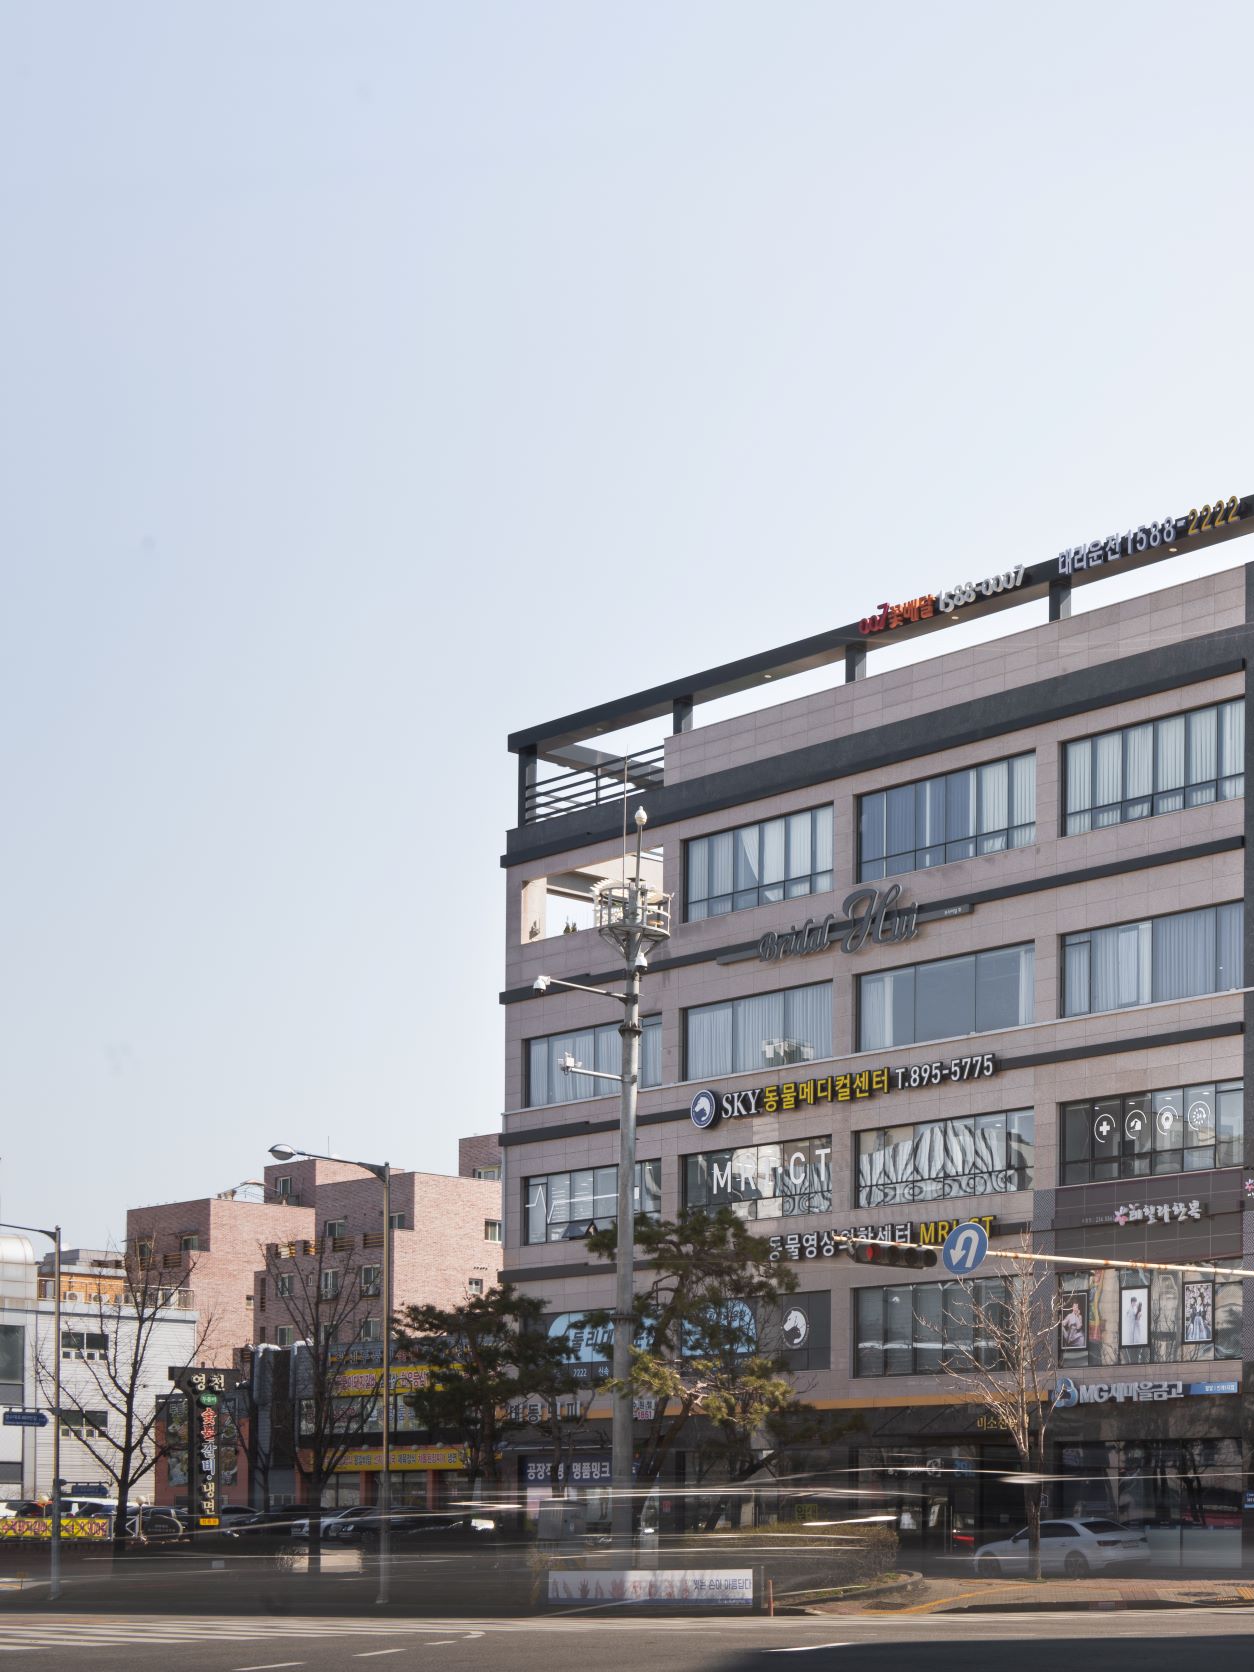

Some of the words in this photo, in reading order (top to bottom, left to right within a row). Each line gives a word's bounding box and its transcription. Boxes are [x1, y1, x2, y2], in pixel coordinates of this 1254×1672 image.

[759, 913, 834, 962] Bridal
[841, 883, 919, 954] Hui
[721, 1089, 763, 1119] SKY
[763, 1067, 891, 1113] 동물메디컬센터
[895, 1053, 995, 1091] T.895-5775
[192, 1373, 225, 1391] 영천
[572, 1462, 611, 1479] 명품밍크
